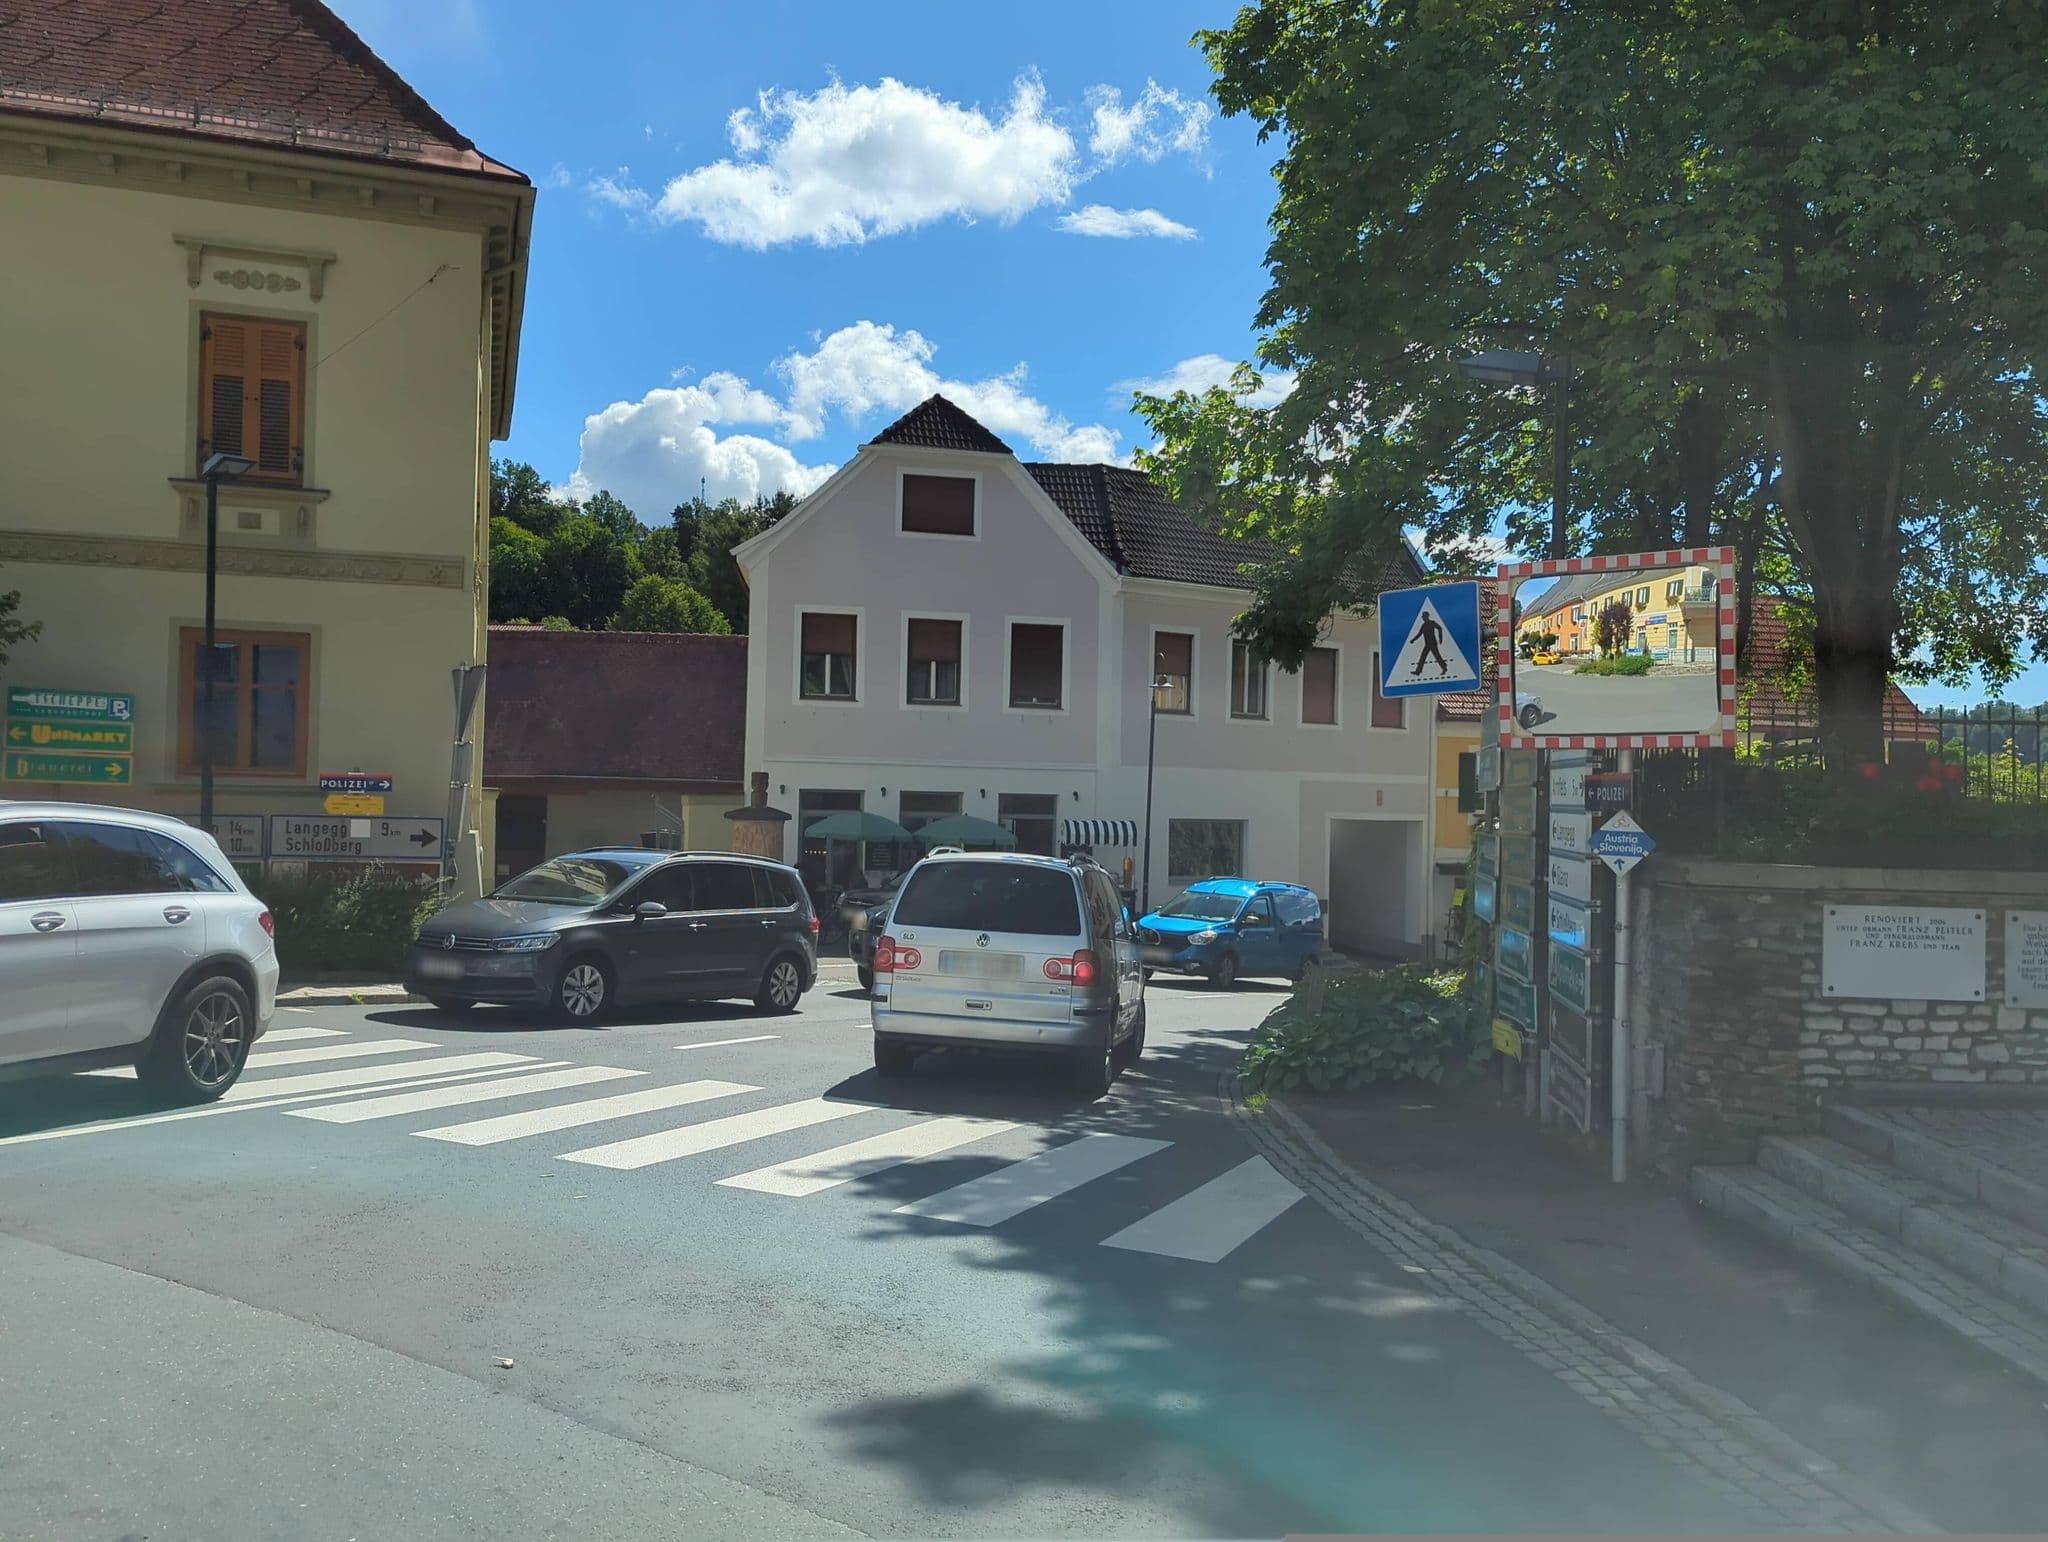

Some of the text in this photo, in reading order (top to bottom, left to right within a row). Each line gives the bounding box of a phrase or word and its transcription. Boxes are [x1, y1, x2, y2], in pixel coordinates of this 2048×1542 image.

[320, 779, 368, 789] POLIZEI
[1597, 787, 1625, 801] POLIZEI
[286, 820, 347, 838] Langegg
[1604, 833, 1638, 844] Austria
[286, 837, 362, 855] Schloßberg
[1600, 842, 1643, 855] Slovenija
[1864, 915, 1920, 924] RENOVIERT
[1896, 925, 1929, 934] FRANZ
[1850, 939, 1882, 948] FRANZ
[1889, 940, 1919, 950] KREBS
